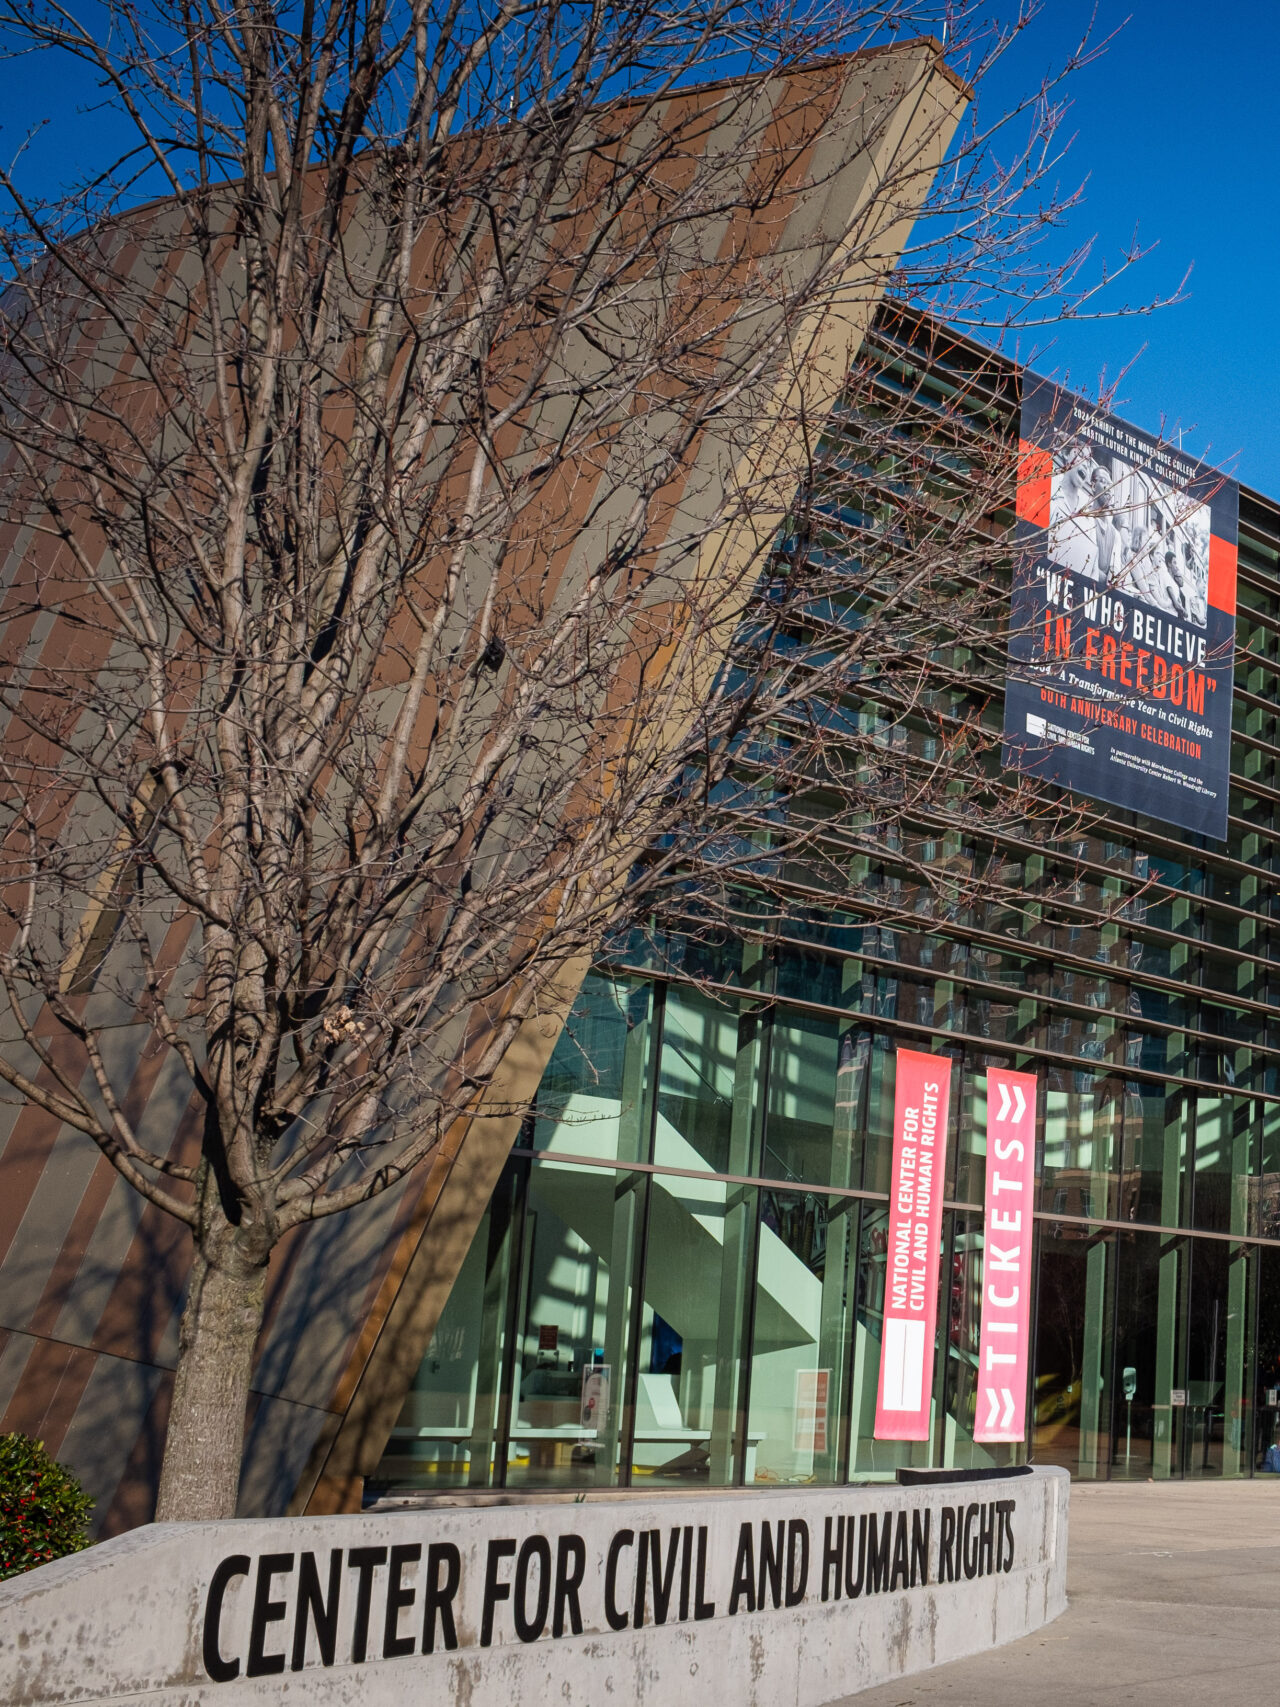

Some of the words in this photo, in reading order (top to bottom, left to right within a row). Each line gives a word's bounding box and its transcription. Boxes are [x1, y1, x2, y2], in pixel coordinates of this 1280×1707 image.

[1073, 407, 1089, 421] 2024
[1091, 416, 1115, 437] EXHIBIT
[1116, 429, 1124, 441] OF
[1125, 434, 1137, 448] THE
[1172, 459, 1196, 479] COLLEGE
[1081, 426, 1104, 445] MARTIN
[1105, 438, 1128, 458] LUTHER
[1129, 450, 1144, 465] KING
[1155, 463, 1188, 486] COLLECTION
[1044, 608, 1072, 660] IN
[1083, 586, 1124, 632] WHO
[1133, 609, 1207, 668] BELIEVE
[1058, 670, 1066, 681] A
[1138, 700, 1157, 717] Year
[1158, 708, 1167, 721] in
[1168, 712, 1188, 727] Civil
[1188, 720, 1213, 738] Rights
[1070, 698, 1138, 736] ANNIVERSARY
[1141, 723, 1201, 760] CELEBRATION
[903, 1106, 919, 1142] FOR
[921, 1082, 939, 1147] RIGHTS
[898, 1148, 917, 1214] CENTER
[916, 1151, 934, 1218] HUMAN
[891, 1219, 912, 1309] NATIONAL
[913, 1222, 929, 1261] AND
[986, 1138, 1024, 1371] TICKETS
[910, 1265, 926, 1311] CIVIL
[202, 1542, 461, 1683] CENTER
[480, 1534, 586, 1647] FOR
[604, 1525, 715, 1631] CIVIL
[728, 1518, 810, 1616] AND
[821, 1508, 931, 1602] HUMAN
[938, 1500, 1016, 1585] RIGHTS
